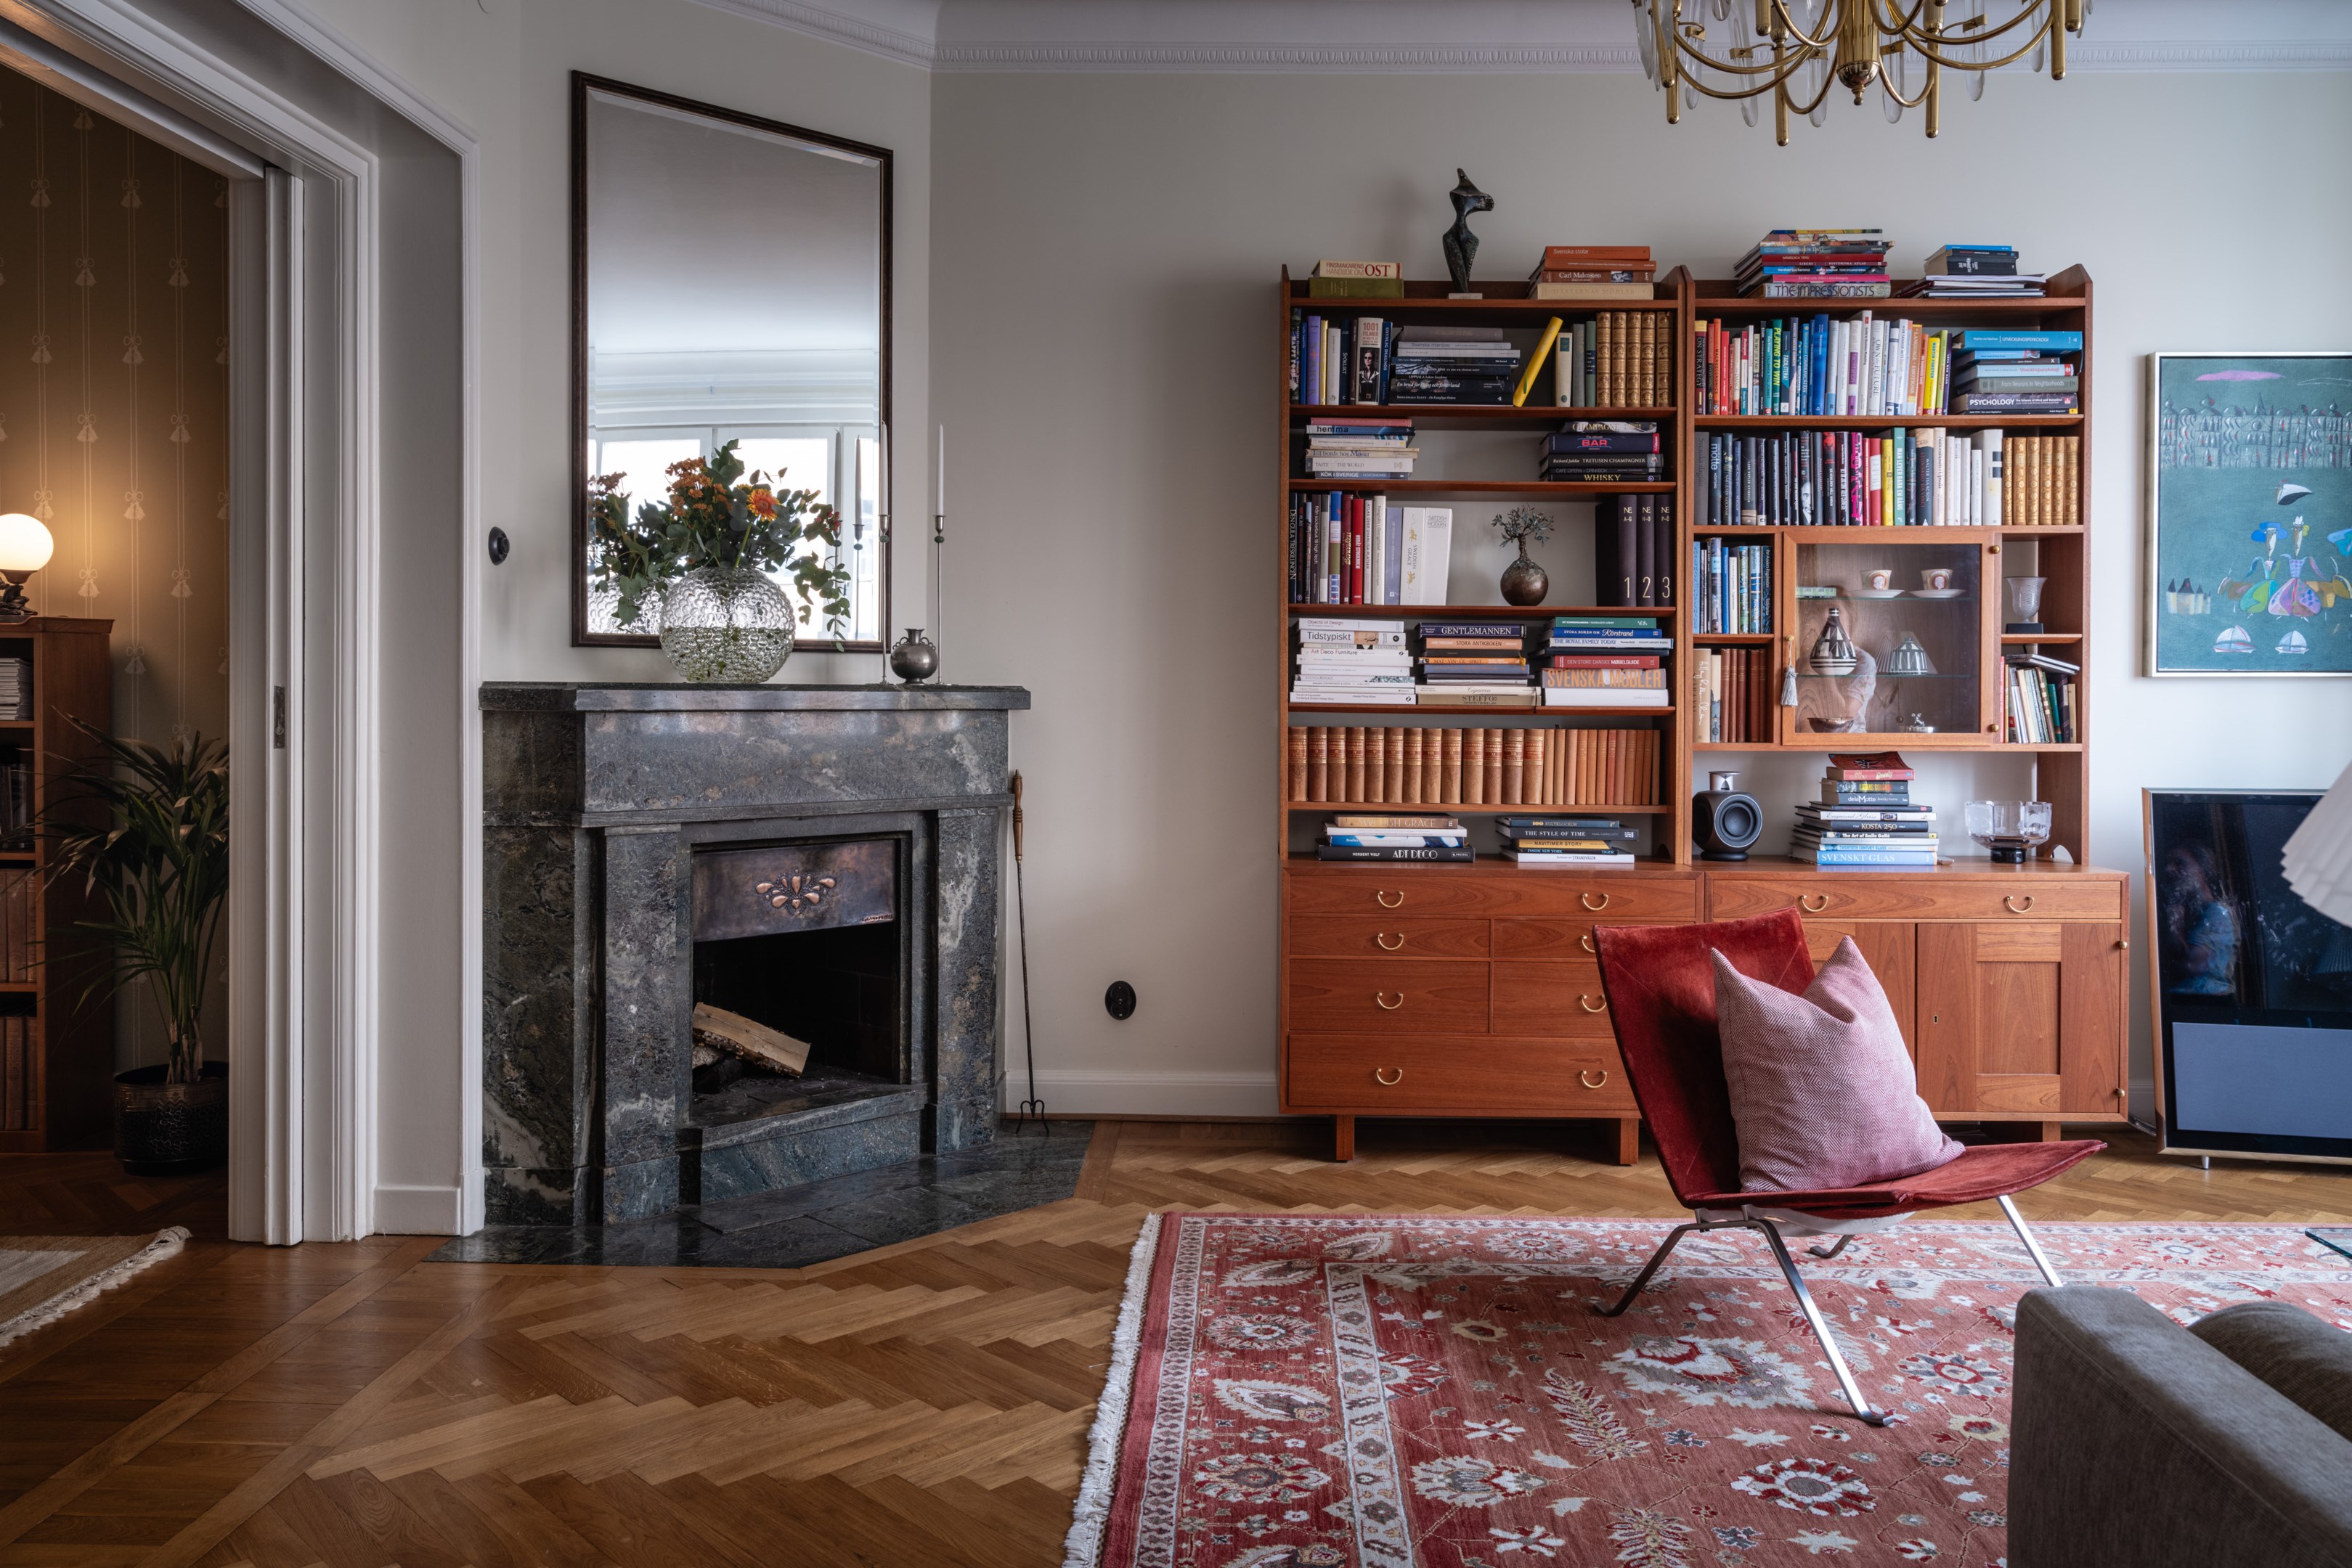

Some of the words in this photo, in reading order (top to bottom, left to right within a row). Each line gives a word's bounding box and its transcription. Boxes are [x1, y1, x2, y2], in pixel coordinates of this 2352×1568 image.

[1365, 264, 1391, 277] OST
[1696, 337, 1703, 348] ON
[1773, 327, 1781, 356] PLAYING
[1773, 359, 1781, 369] TO
[1572, 422, 1619, 431] CHAMPAGNE
[1711, 444, 1720, 470] motte
[1624, 576, 1630, 598] 1
[1643, 576, 1651, 598] 2
[1662, 576, 1670, 598] 3
[1307, 632, 1351, 642] Tidstypiskt
[1547, 669, 1605, 687] SVENSKA
[1610, 669, 1661, 688] MÖBLER
[1693, 661, 1709, 679] Hillary
[1698, 702, 1709, 726] Clinton
[1393, 850, 1409, 859] ART
[1411, 850, 1438, 859] DECO
